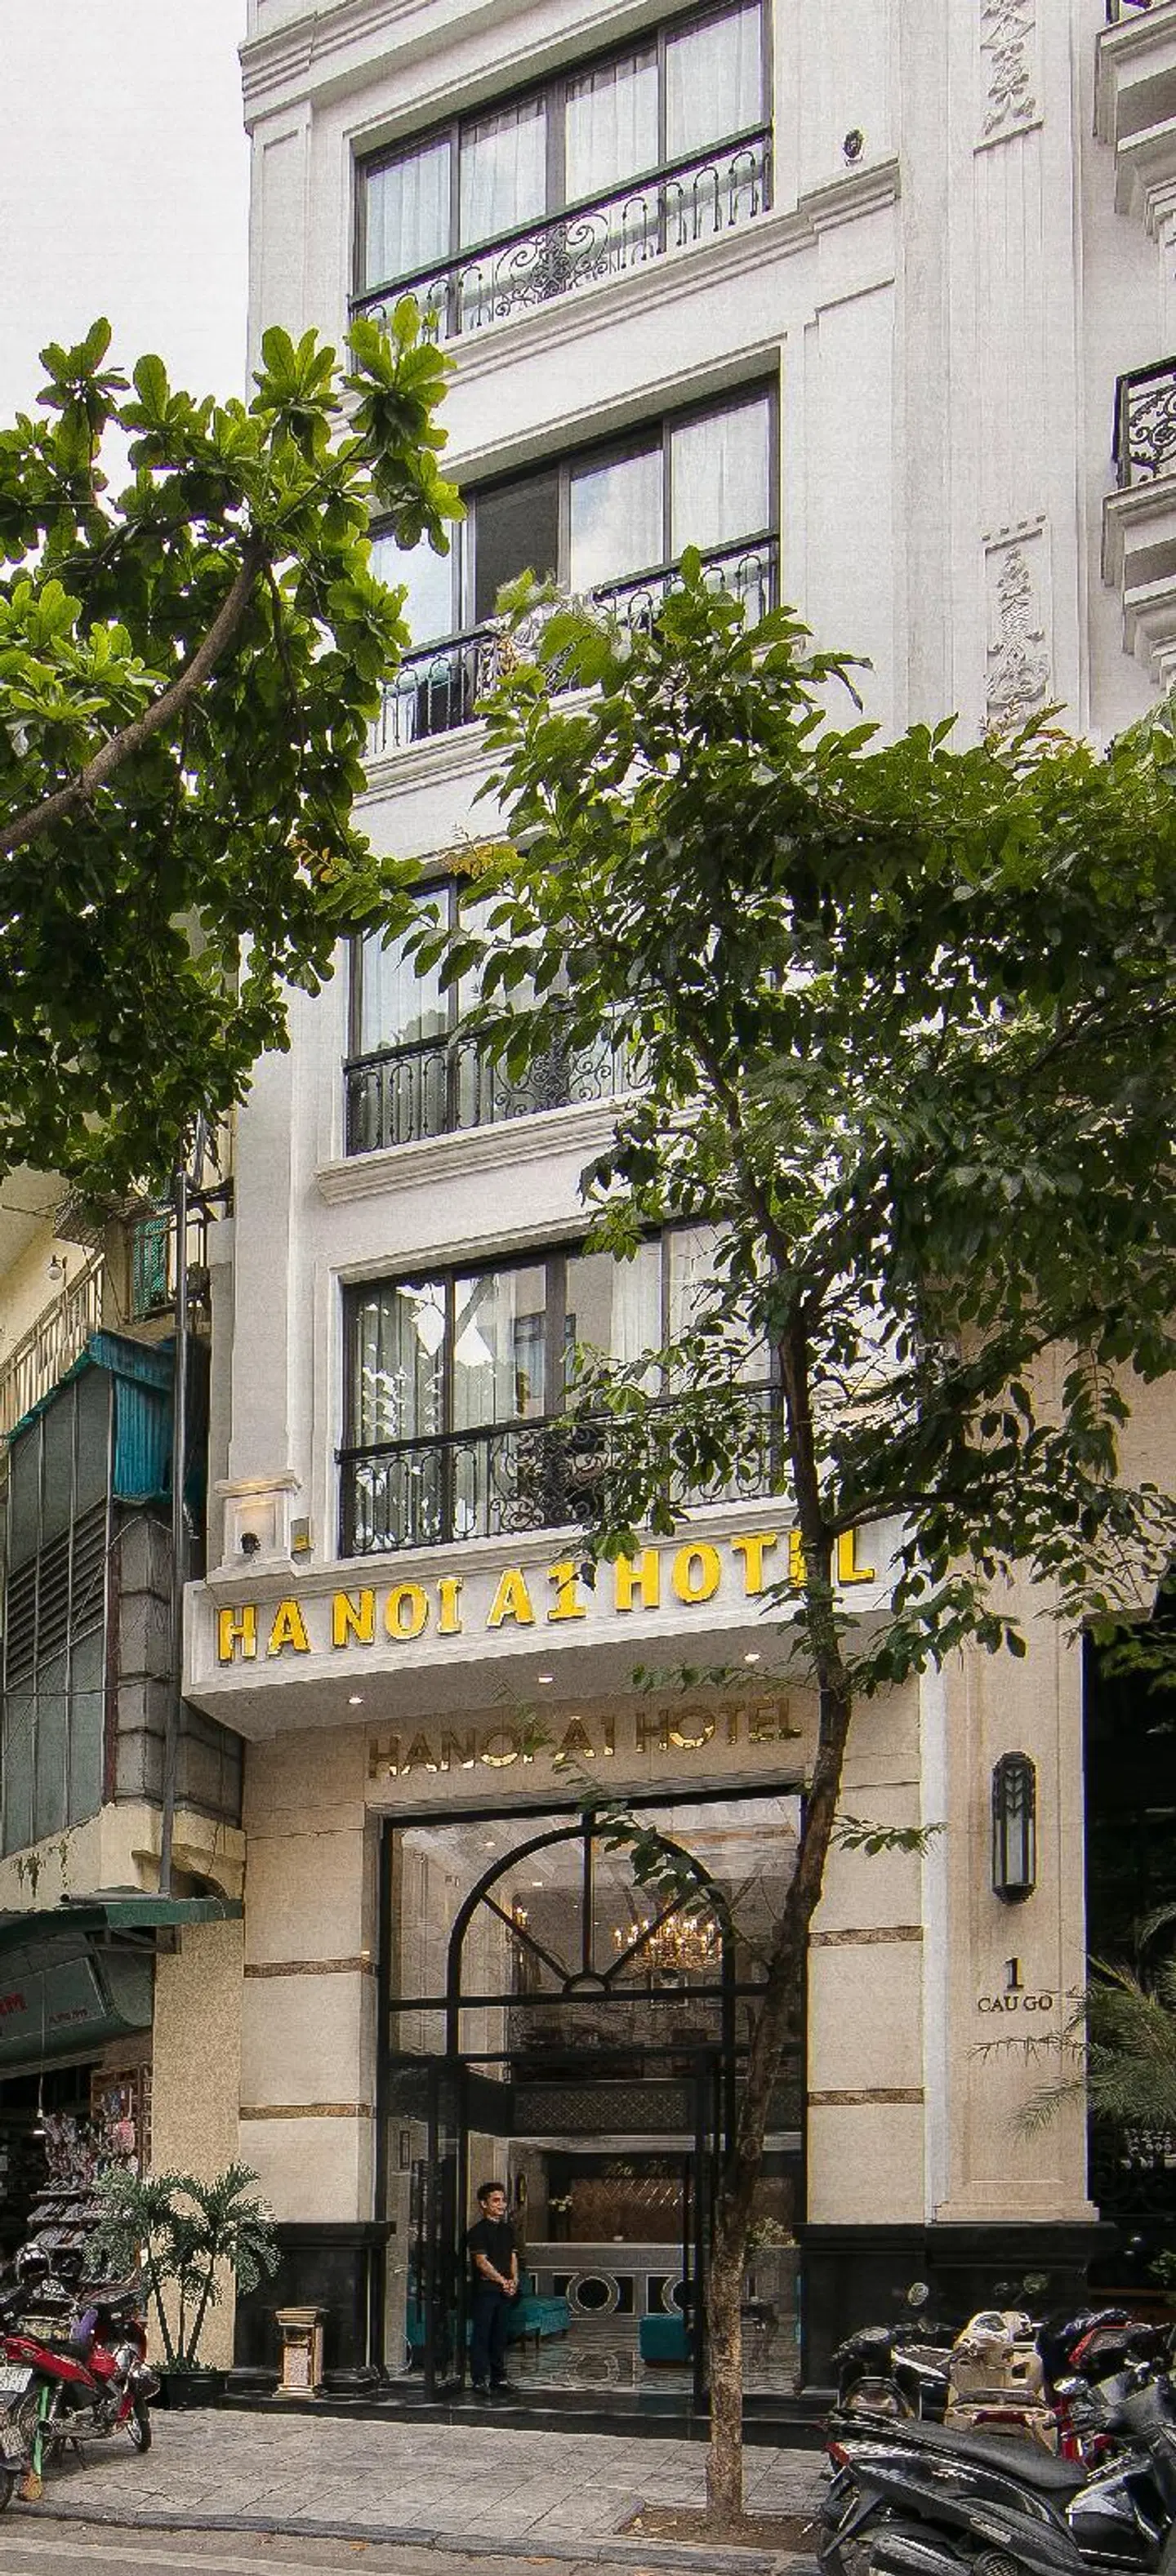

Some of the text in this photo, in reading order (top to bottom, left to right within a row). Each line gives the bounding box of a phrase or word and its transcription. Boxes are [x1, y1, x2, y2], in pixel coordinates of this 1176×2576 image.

[486, 1561, 587, 1628] A1
[368, 1723, 536, 1779] HANOI
[635, 1696, 802, 1754] HOTEL
[1004, 1957, 1024, 1989] 1
[978, 1994, 1054, 2013] CAU GO
